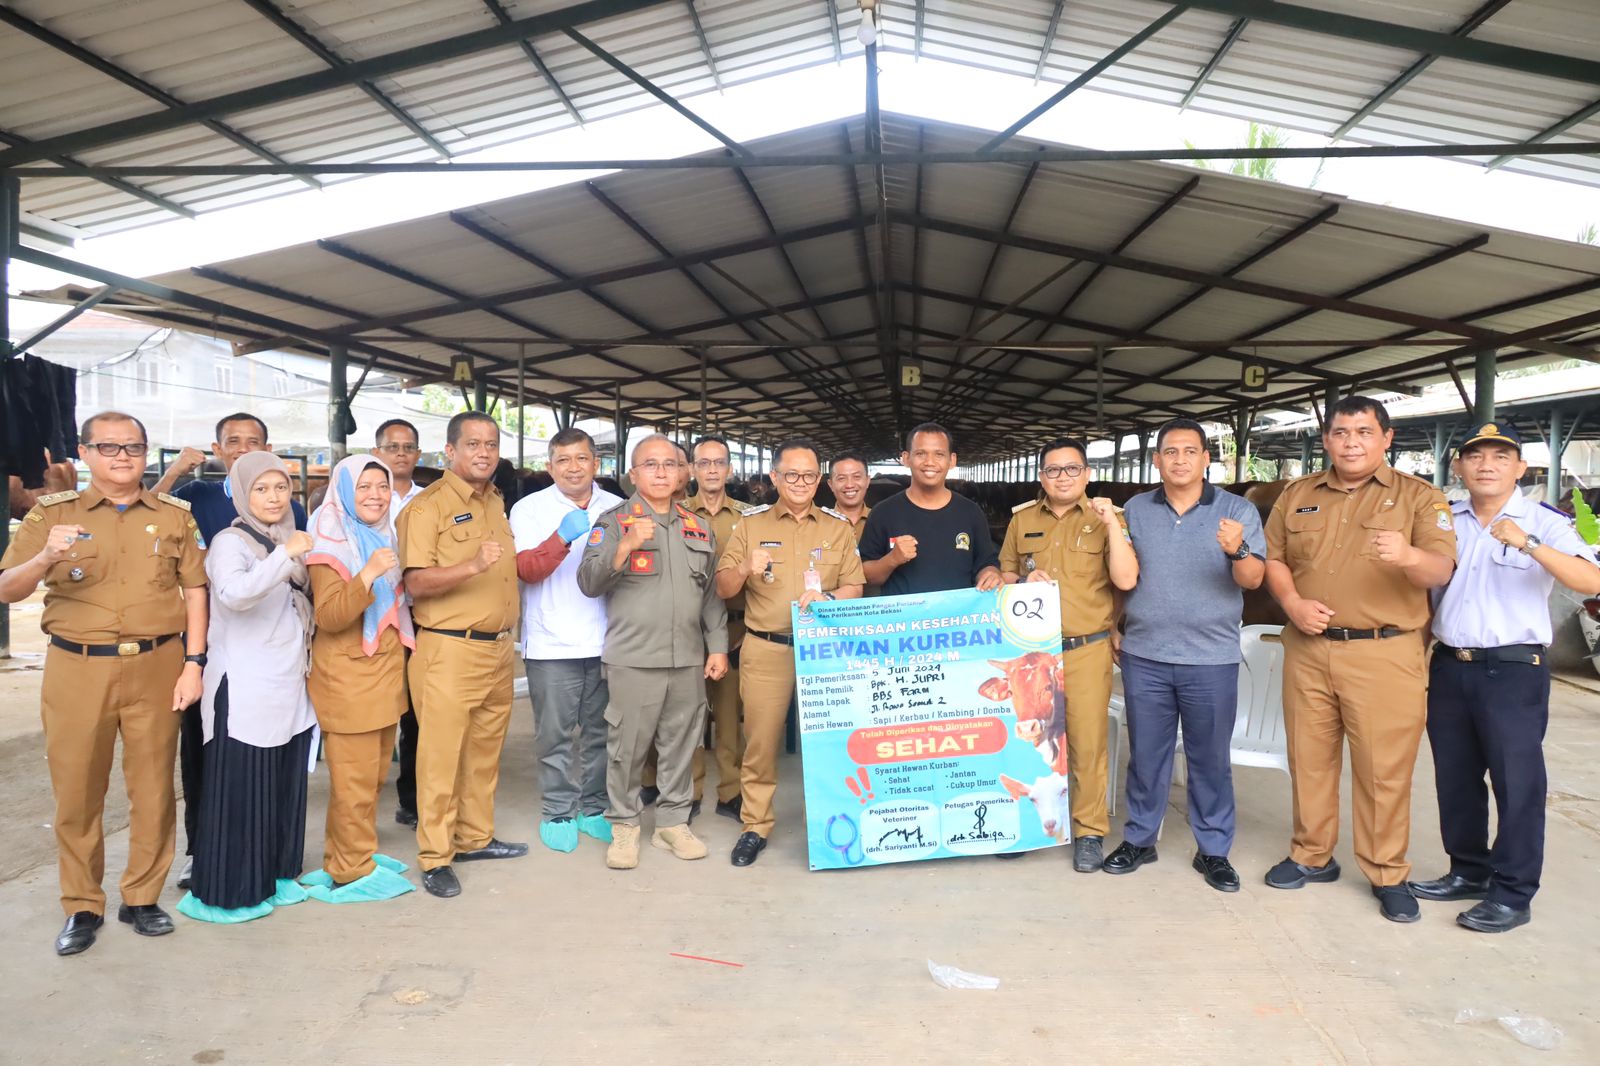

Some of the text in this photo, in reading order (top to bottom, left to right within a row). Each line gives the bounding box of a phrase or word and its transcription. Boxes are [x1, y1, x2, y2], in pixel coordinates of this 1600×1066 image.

[454, 362, 472, 380] A
[902, 366, 920, 386] B
[1245, 366, 1264, 386] C
[1012, 598, 1044, 620] 02
[798, 612, 1001, 639] PEMERIKSAAN KESEHATAN
[800, 628, 1002, 661] HEWAN KURBAN
[847, 657, 880, 670] 1445
[884, 656, 894, 667] H
[908, 653, 943, 665] 2024
[948, 651, 960, 662] M
[800, 677, 813, 686] Tgl
[888, 666, 910, 675] Juni
[915, 664, 940, 672] 2024
[826, 685, 854, 694] Pemilik
[912, 673, 944, 684] JUPRI
[803, 710, 830, 719] Alamat
[938, 696, 946, 704] 2
[826, 698, 850, 706] Lapak
[872, 690, 892, 702] BBS
[826, 721, 854, 729] Hewan
[873, 717, 892, 726] Sapi
[900, 714, 930, 722] Kerbau
[938, 709, 975, 719] Kambing
[983, 706, 1011, 714] Domba
[860, 720, 993, 739] Telah Diperiksa dan Dinyatakan
[876, 734, 980, 758] SEHAT
[874, 762, 960, 776] Syarat Hewan Kurban:
[950, 770, 976, 778] Jantan
[888, 776, 910, 784] Sehat
[890, 784, 934, 794] Tidak cacat
[950, 780, 975, 789] Cukup
[869, 805, 929, 816] Pejabat Otoritas
[944, 797, 1014, 810] Petugas Pemeriksa
[884, 843, 918, 852] Sariyanti
